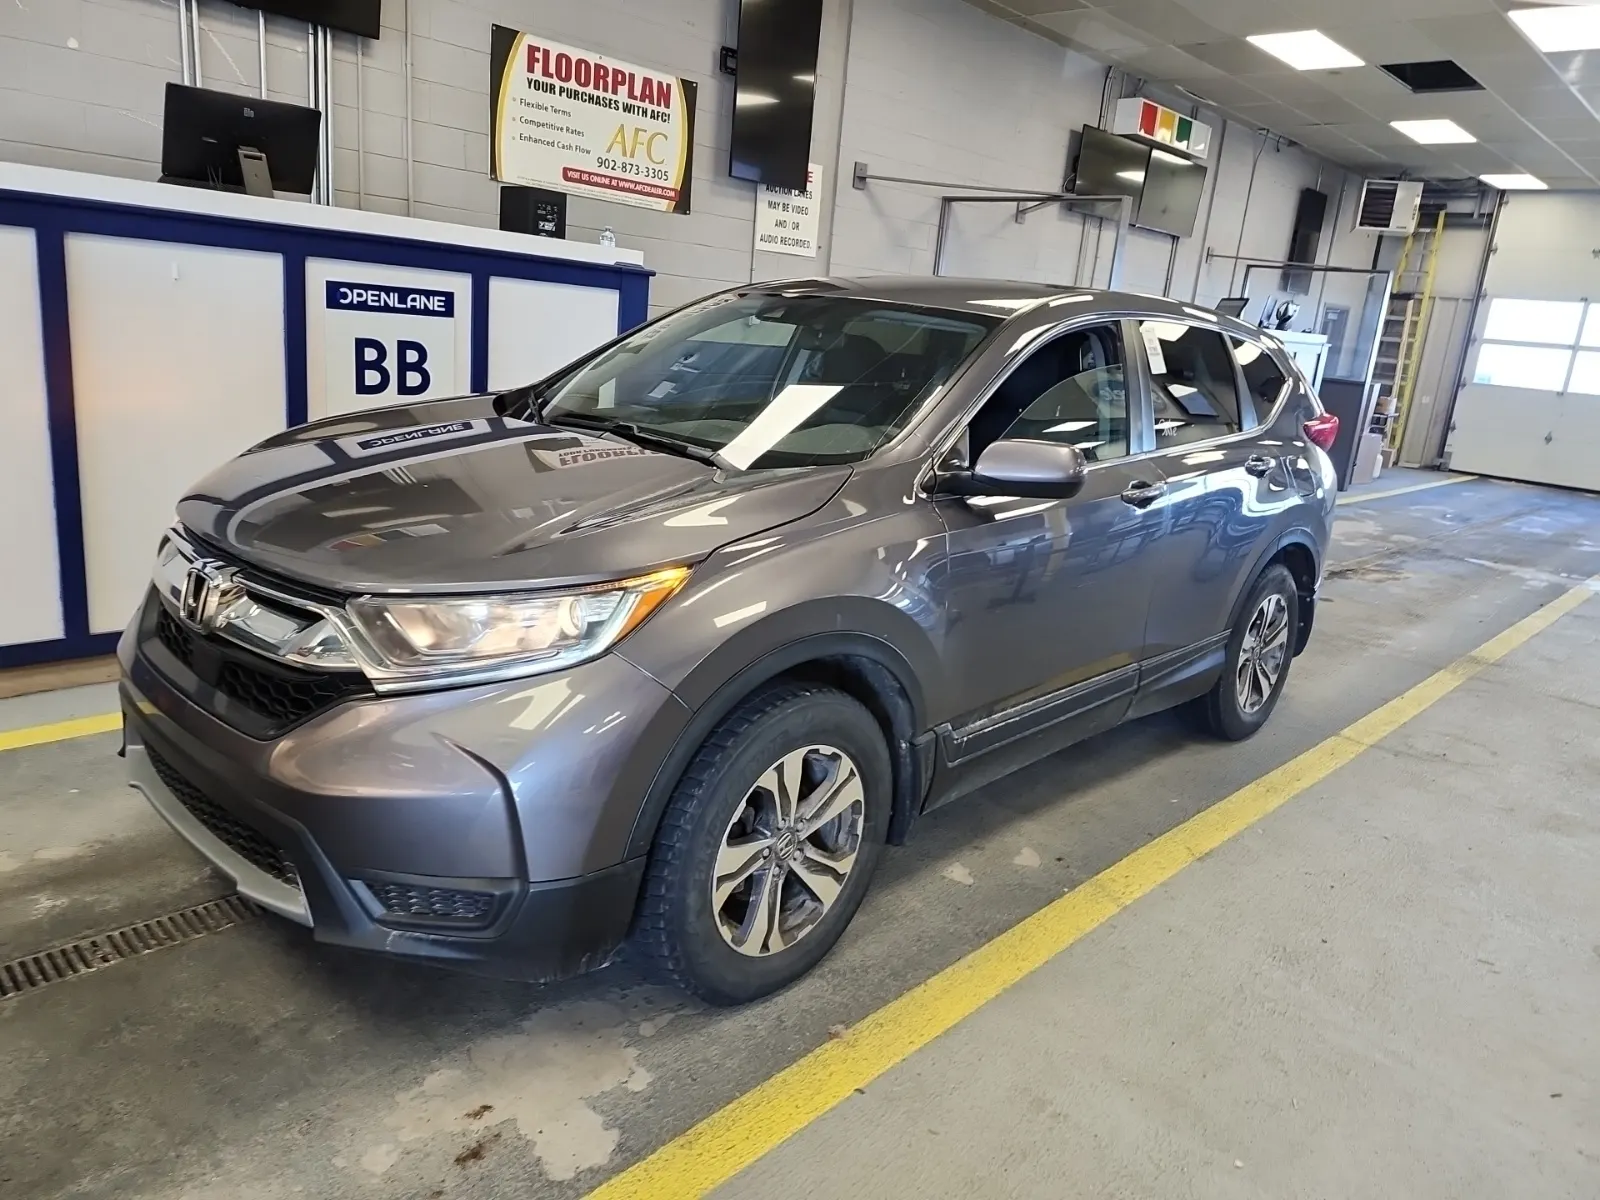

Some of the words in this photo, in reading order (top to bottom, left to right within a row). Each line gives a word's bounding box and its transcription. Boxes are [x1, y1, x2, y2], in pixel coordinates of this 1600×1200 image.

[526, 44, 672, 110] FLOORPLAN
[519, 98, 549, 113] Flexible
[550, 105, 572, 118] Terms
[526, 77, 557, 96] YOUR
[559, 85, 620, 112] PURCHASES
[622, 101, 648, 119] WITH
[649, 109, 671, 124] AFC!
[519, 116, 565, 133] Competitive
[565, 126, 585, 138] Rates
[519, 133, 556, 148] Enhanced
[556, 141, 574, 152] Cash
[574, 145, 592, 156] Flow
[605, 123, 669, 165] AFC
[596, 156, 670, 182] 902-873-3305
[567, 170, 581, 180] VISIT
[581, 173, 590, 181] US
[590, 175, 611, 185] ONLINE
[611, 179, 618, 188] AT
[618, 180, 676, 198] WWW.AFCDEALER.COM
[765, 184, 793, 197] AUCTION
[767, 200, 781, 211] MAY
[781, 202, 790, 213] BE
[791, 204, 809, 216] VIDEO
[774, 219, 788, 229] AND
[791, 221, 800, 232] OR
[759, 233, 779, 245] AUDIO
[779, 236, 812, 249] RECORDED.
[337, 287, 446, 312] OPENLANE
[354, 337, 431, 396] BB
